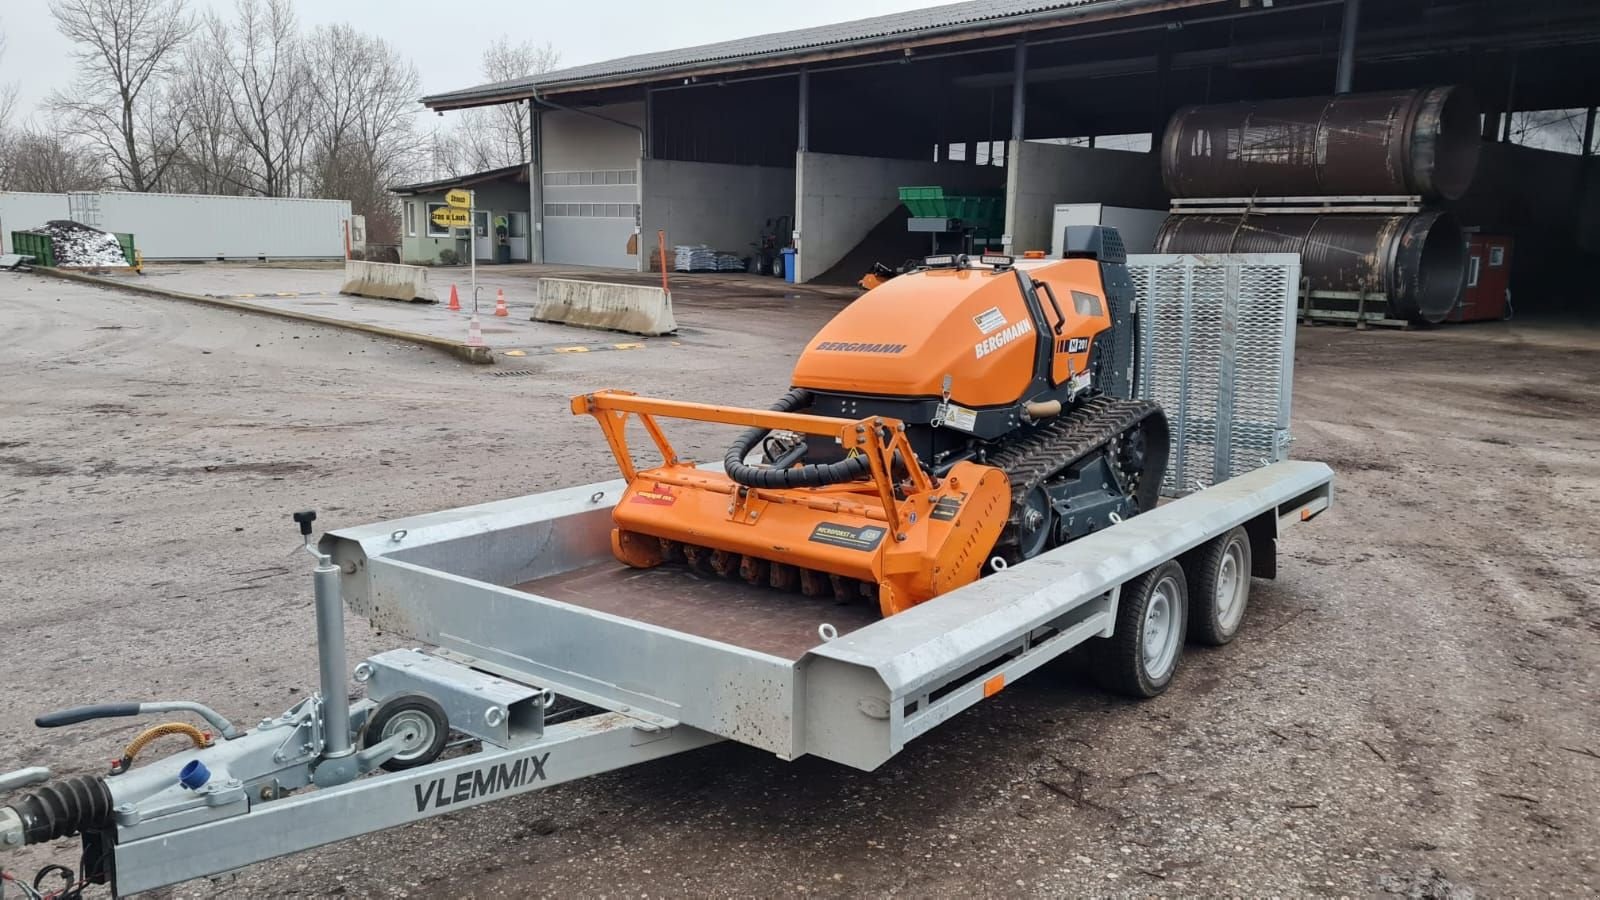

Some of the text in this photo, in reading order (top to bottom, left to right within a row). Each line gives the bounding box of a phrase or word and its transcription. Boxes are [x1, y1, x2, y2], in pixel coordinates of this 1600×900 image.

[816, 341, 907, 354] BERGMANN
[975, 318, 1032, 360] BERGMANN
[1078, 339, 1088, 350] 201
[414, 752, 551, 813] VLEMMIX
